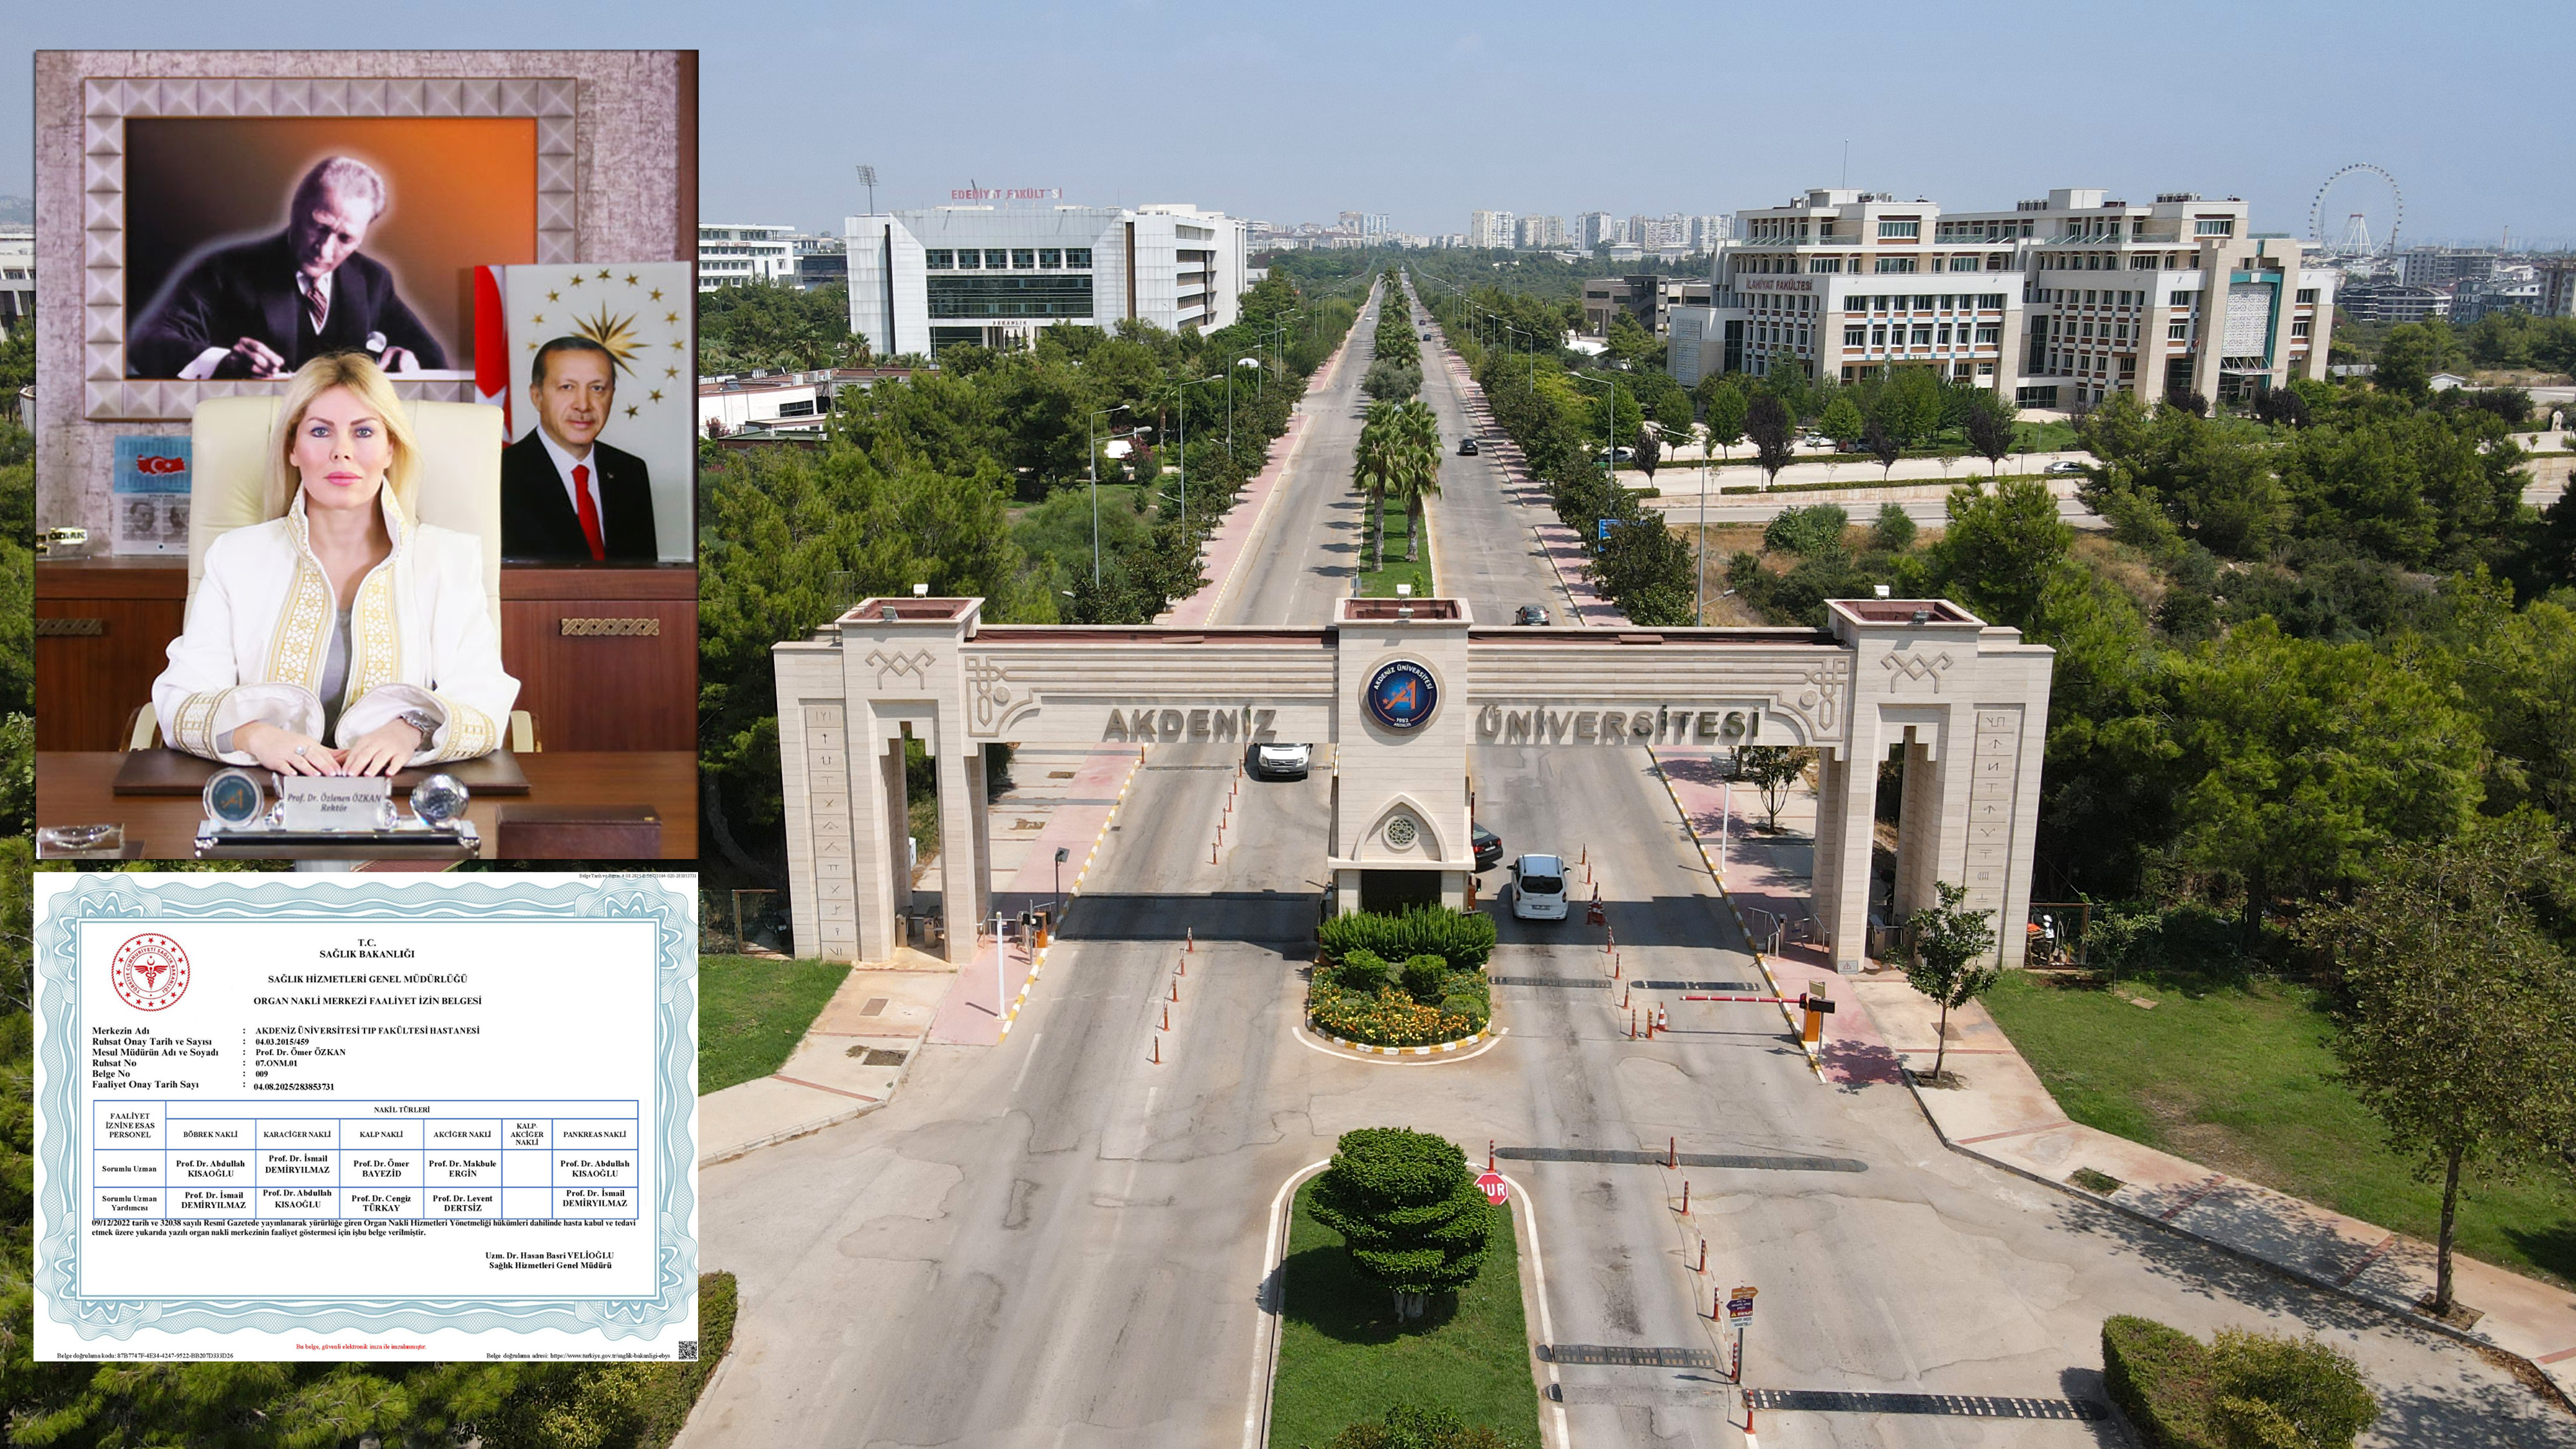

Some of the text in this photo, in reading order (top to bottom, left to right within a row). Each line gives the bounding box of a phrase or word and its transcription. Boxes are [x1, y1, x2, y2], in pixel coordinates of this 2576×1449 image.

[951, 187, 1001, 200] EDEBİYAT
[1776, 278, 1813, 291] FAKÜLTESİ
[1373, 664, 1434, 690] AKDENİZ ÜNİVERSİTESİ
[1103, 703, 1760, 739] AKDENİZ ÜNİVERSİTESİ
[287, 791, 382, 802] Prof. Dr. Özlenen ÖZKAN
[321, 803, 348, 812] Rektör
[319, 949, 415, 958] SAĞLIK BAKANLIĞI
[126, 947, 156, 971] CUMHURİYETİ
[126, 972, 140, 994] TÜRKİYE
[268, 974, 304, 983] SAĞLIK
[306, 974, 366, 983] HİZMETLERİ
[403, 974, 468, 983] MÜDÜRLÜĞÜ
[290, 996, 321, 1005] NAKLİ
[323, 996, 367, 1005] MERKEZİ
[369, 996, 417, 1005] FAALİYET
[419, 996, 439, 1005] İZİN
[442, 996, 482, 1005] BELGESİ
[256, 1025, 296, 1034] AKDENİZ
[298, 1025, 359, 1034] ÜNİVERSİTESİ
[378, 1025, 428, 1034] FAKÜLTESİ
[430, 1025, 480, 1034] HASTANESİ
[124, 1038, 147, 1047] Onay
[186, 1038, 212, 1047] Sayısı
[120, 1046, 159, 1056] Müdürün
[189, 1046, 219, 1058] Soyadı
[290, 1047, 312, 1056] Ömer
[314, 1047, 346, 1056] ÖZKAN
[92, 1070, 115, 1079] Belge
[92, 1081, 126, 1090] Faaliyet
[128, 1081, 152, 1090] Onay
[180, 1081, 199, 1090] Sayı
[304, 1153, 328, 1162] İsmail
[387, 1159, 410, 1168] Ömer
[188, 1169, 234, 1177] KISAOĞLU
[265, 1165, 330, 1173] DEMİRYILMAZ
[362, 1169, 402, 1177] BAYEZİD
[449, 1169, 477, 1177] ERGİN
[572, 1169, 618, 1177] KISAOĞLU
[182, 1220, 202, 1228] sayılı
[261, 1220, 307, 1228] yayınlanarak
[308, 1220, 343, 1228] yürürlüğe
[344, 1220, 362, 1228] giren
[363, 1220, 387, 1228] Organ
[450, 1220, 491, 1228] Yönetmeliği
[567, 1251, 614, 1259] VELİOĞLU
[489, 1262, 513, 1271] Sağlık
